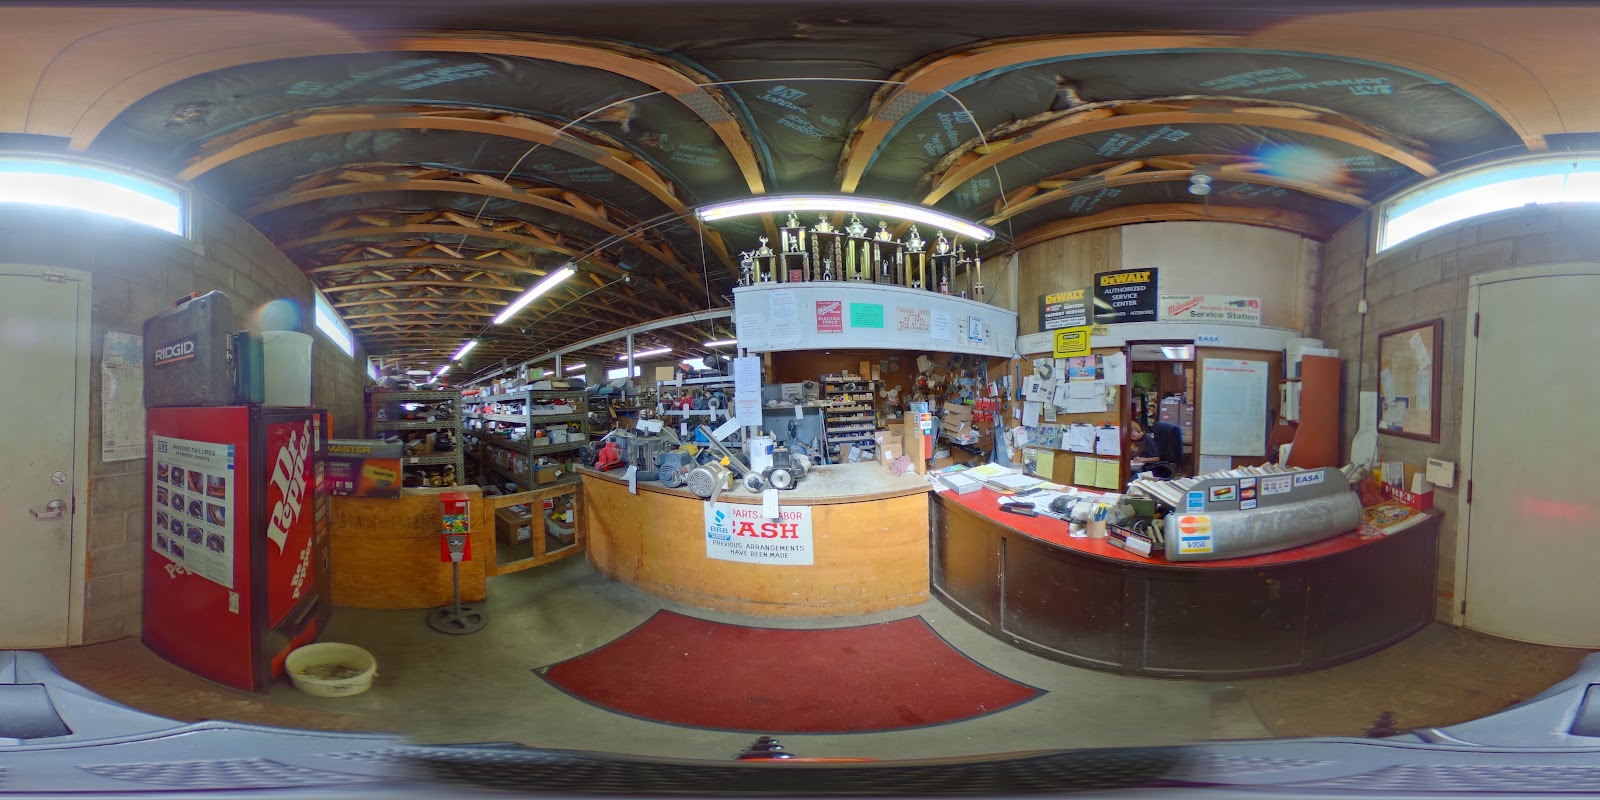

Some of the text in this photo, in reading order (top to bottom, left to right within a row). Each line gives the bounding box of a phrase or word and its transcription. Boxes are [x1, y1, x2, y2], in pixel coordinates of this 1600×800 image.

[1104, 285, 1146, 295] AUTHORIZED
[1111, 293, 1138, 301] SERVICE
[1112, 299, 1137, 308] CENTER
[1190, 310, 1259, 321] Service Station
[155, 340, 195, 362] RIDGID
[172, 444, 216, 457] WINDING FAILURES
[180, 451, 194, 459] electric
[194, 454, 210, 462] motors
[270, 429, 299, 504] Dr
[1295, 474, 1320, 484] EASA
[267, 420, 311, 556] Pepper
[778, 511, 803, 520] ABOR
[710, 525, 729, 534] BBB
[712, 539, 805, 552] PREVIOUS ARRANGEMENTS
[1187, 541, 1205, 549] VISA
[730, 549, 748, 557] HAVE
[769, 551, 789, 559] MADE
